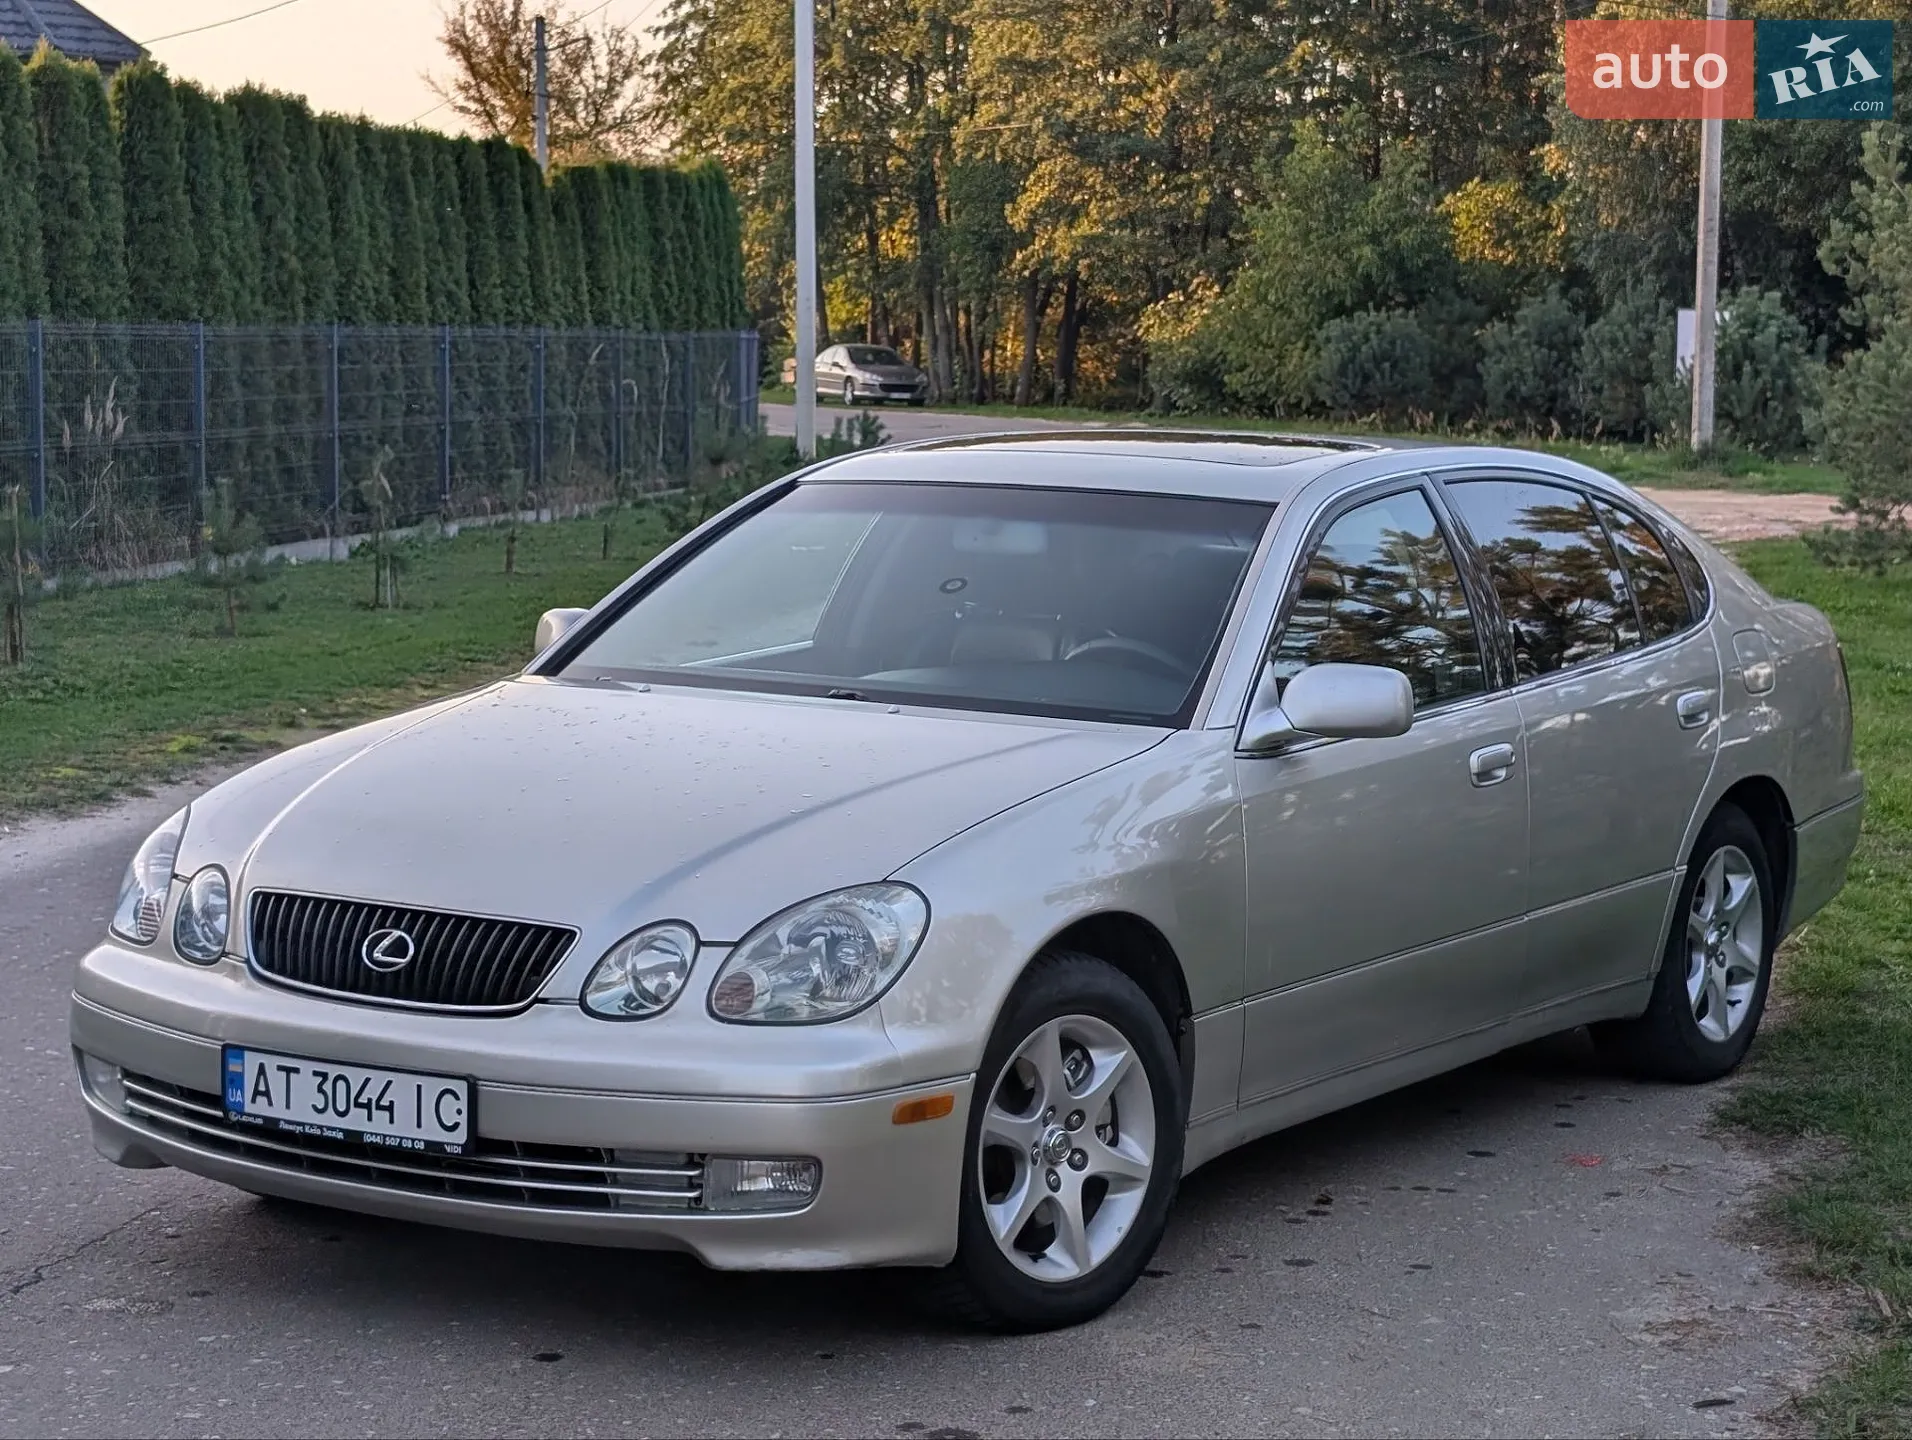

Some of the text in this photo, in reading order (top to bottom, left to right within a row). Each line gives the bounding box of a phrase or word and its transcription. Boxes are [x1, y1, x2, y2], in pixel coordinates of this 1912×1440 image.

[228, 1088, 243, 1103] UA
[250, 1061, 463, 1132] AT 3044 IC
[385, 1136, 400, 1146] 507
[444, 1144, 462, 1154] VIDI
